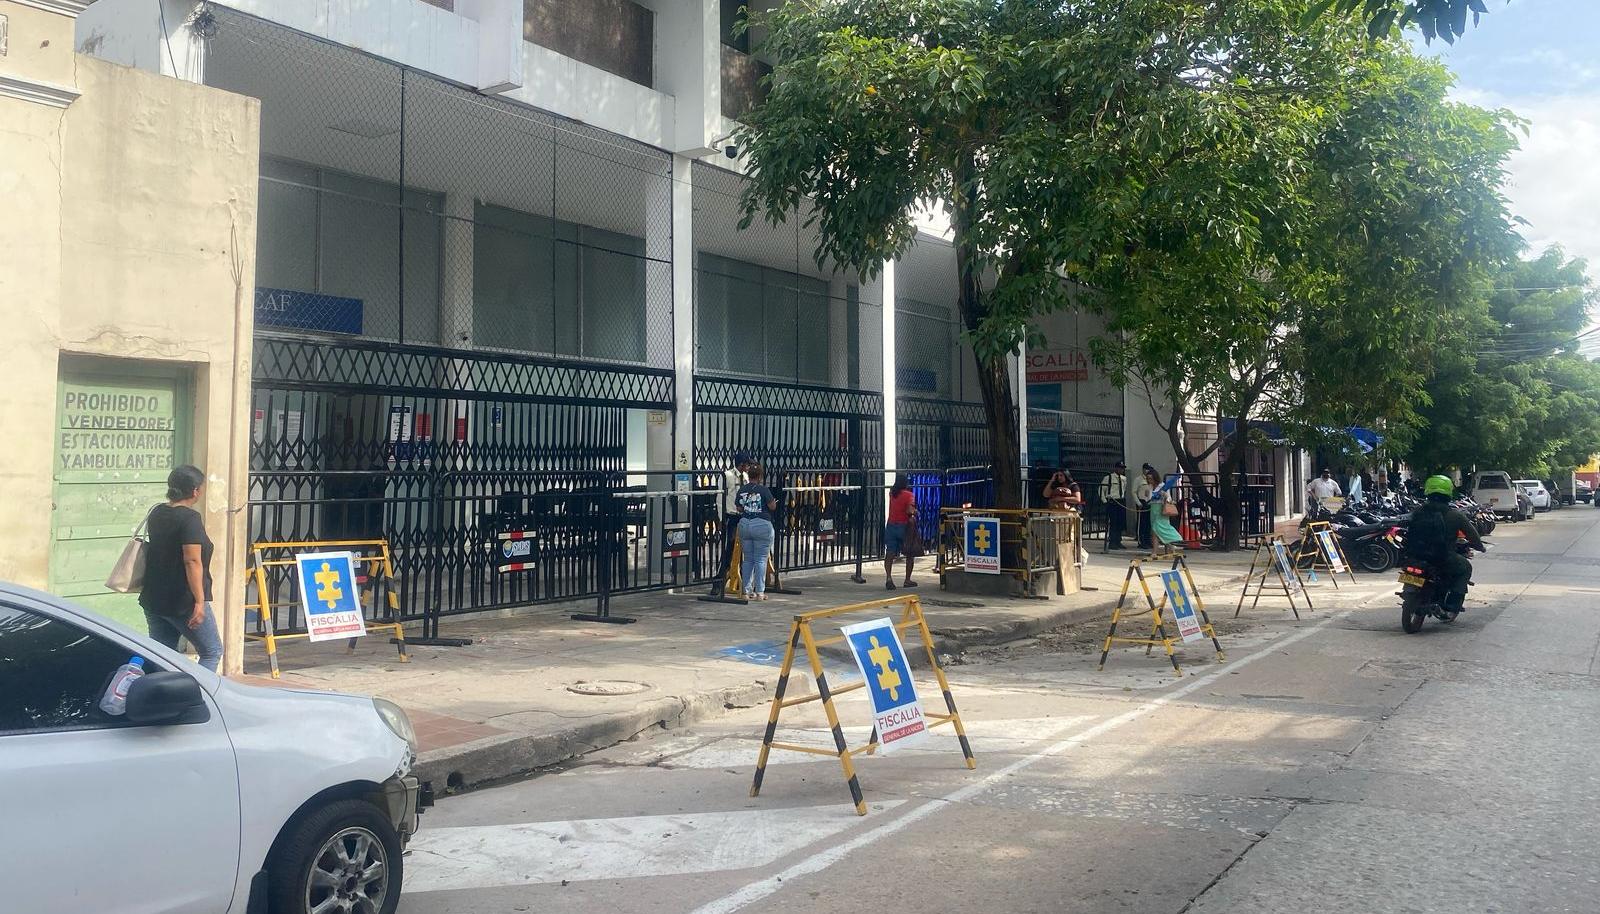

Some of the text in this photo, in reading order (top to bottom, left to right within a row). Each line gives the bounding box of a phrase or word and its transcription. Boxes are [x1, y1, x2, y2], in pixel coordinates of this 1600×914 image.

[65, 392, 159, 412] PROHIBIDO
[68, 414, 174, 430] VENDEDORES
[61, 433, 173, 449] ESTACIONARIOS
